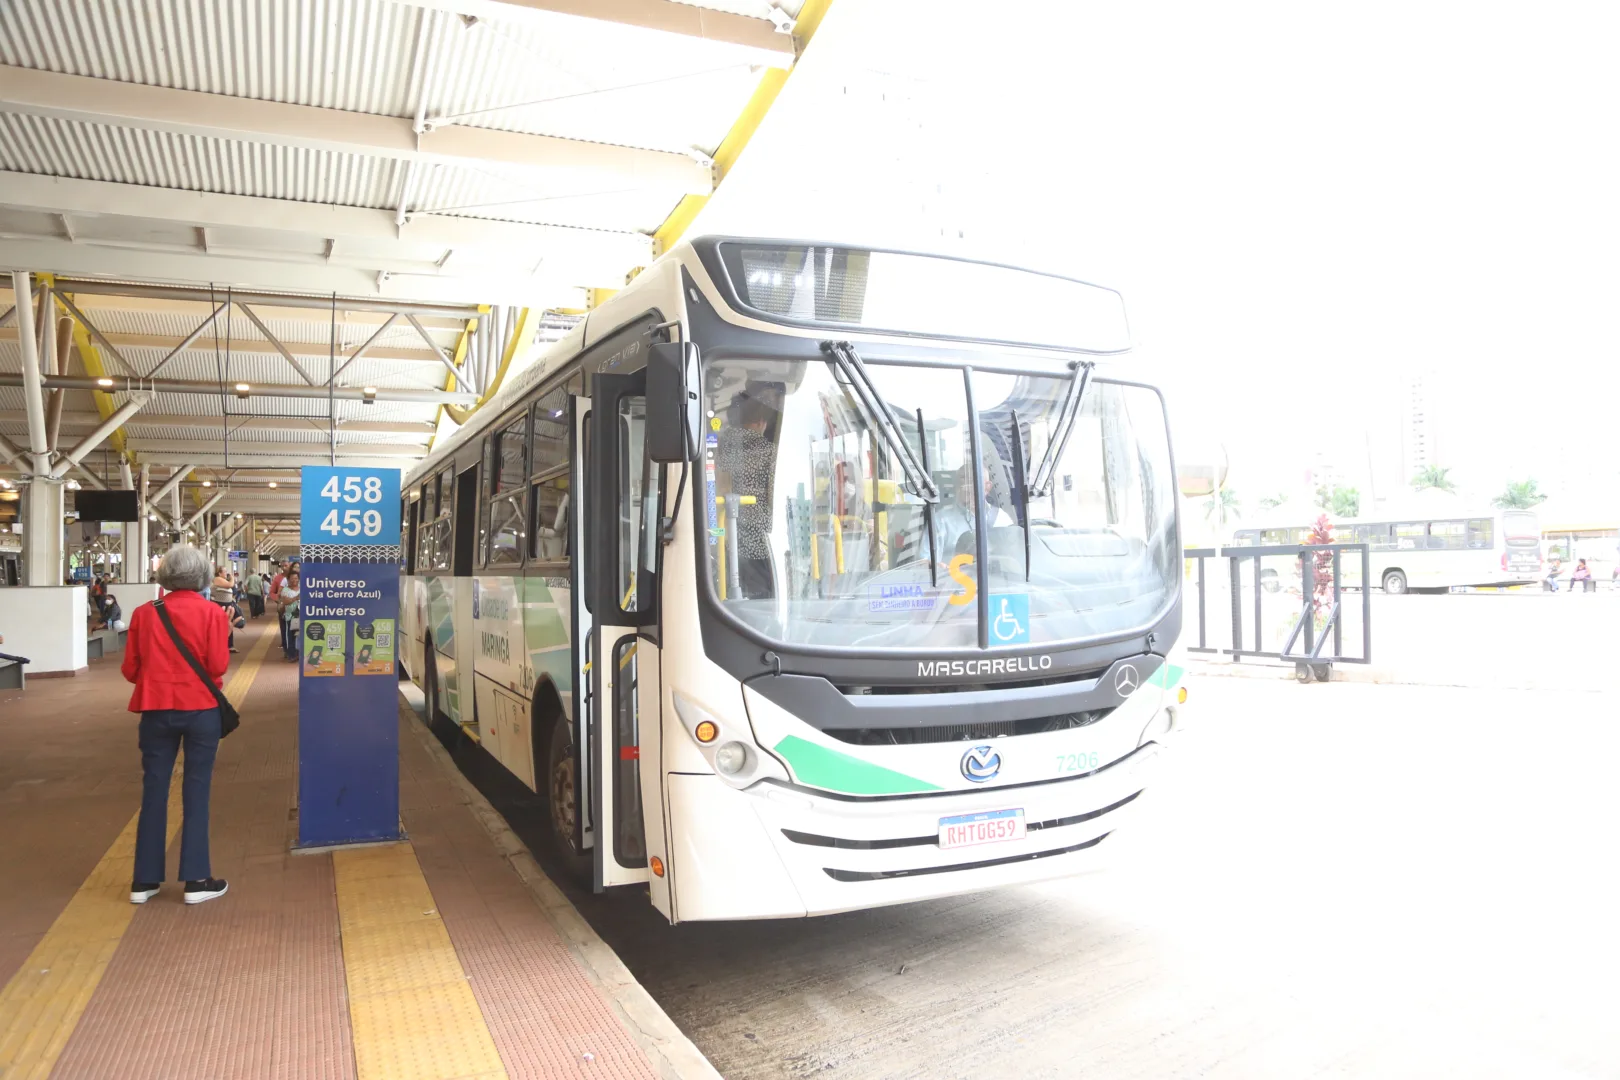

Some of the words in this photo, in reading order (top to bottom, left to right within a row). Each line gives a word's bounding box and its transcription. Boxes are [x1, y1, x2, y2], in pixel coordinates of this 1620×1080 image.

[321, 475, 382, 504] 458
[320, 509, 382, 537] 459
[306, 577, 366, 589] Universo
[949, 553, 977, 606] S
[309, 590, 324, 599] via
[326, 590, 354, 599] Cerro
[356, 589, 382, 600] Azul)
[881, 585, 924, 598] LINHA
[305, 605, 366, 616] Universo
[326, 622, 342, 633] 459
[375, 621, 392, 632] 458
[481, 631, 510, 666] MARINGÁ
[917, 655, 1052, 677] MASCARELLO
[1056, 751, 1099, 773] 7206
